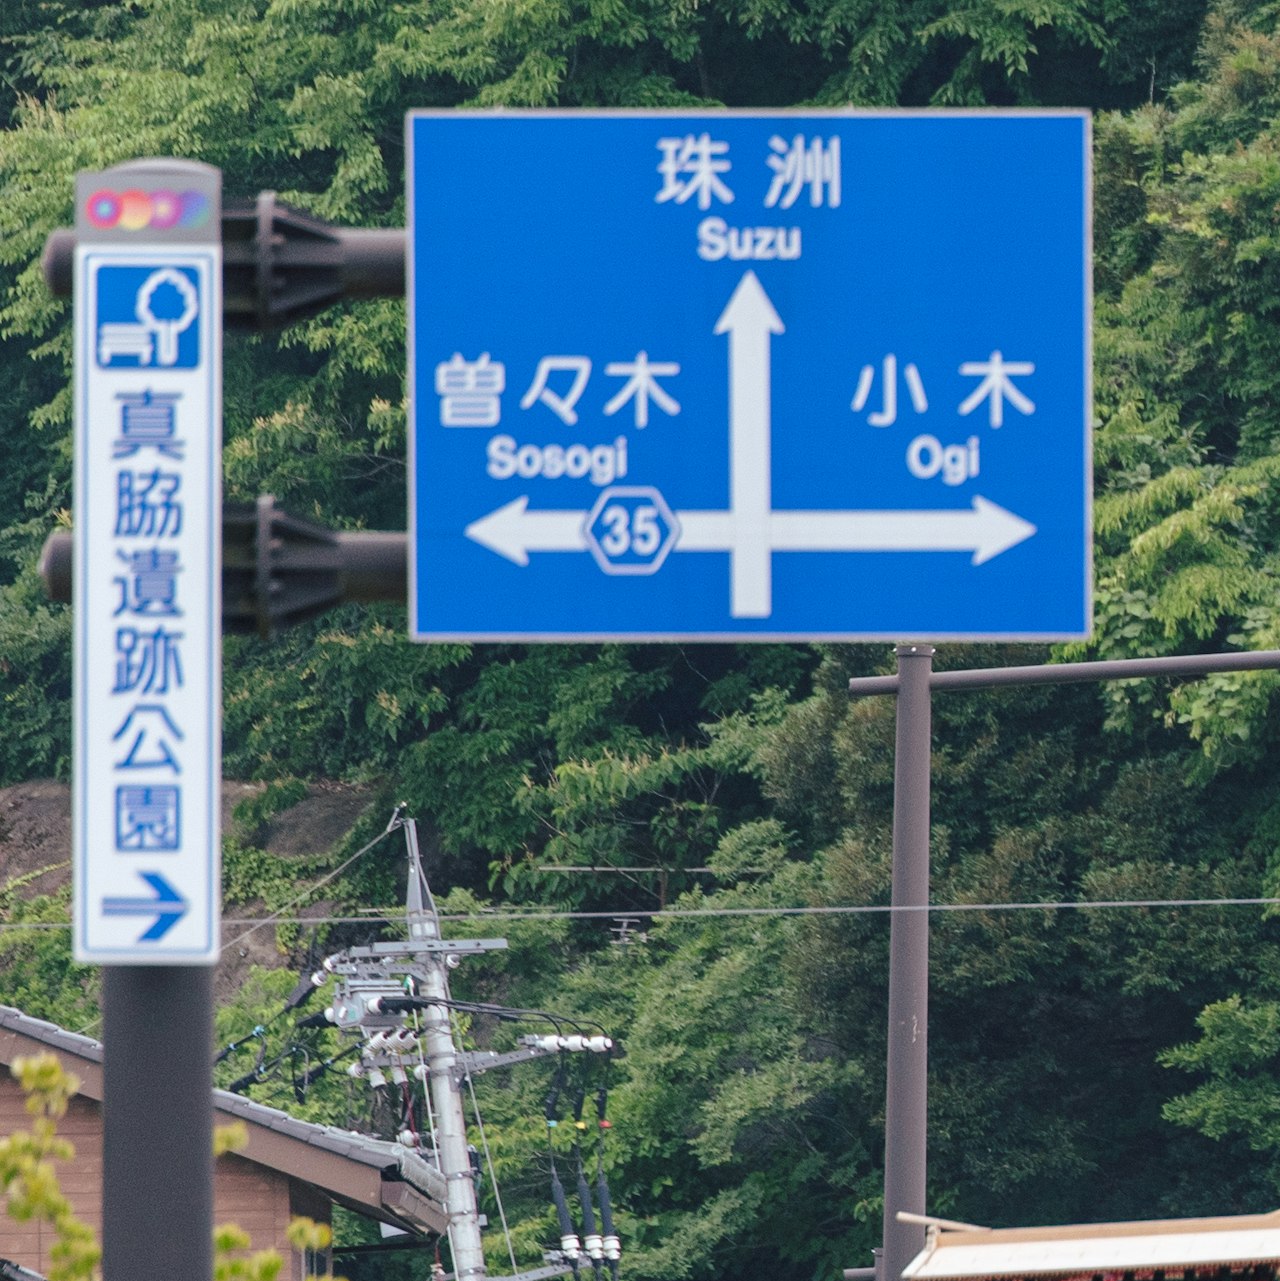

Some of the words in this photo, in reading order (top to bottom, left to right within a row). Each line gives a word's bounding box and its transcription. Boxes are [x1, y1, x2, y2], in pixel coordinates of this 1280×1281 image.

[656, 134, 842, 210] 珠洲
[698, 217, 803, 263] Suzu
[435, 350, 682, 429] 曽々木
[851, 350, 1036, 429] 小木
[486, 434, 628, 487] Sosogi
[906, 434, 981, 486] Ogi
[601, 506, 661, 553] 35
[110, 388, 185, 853] 真脇遺跡公園
